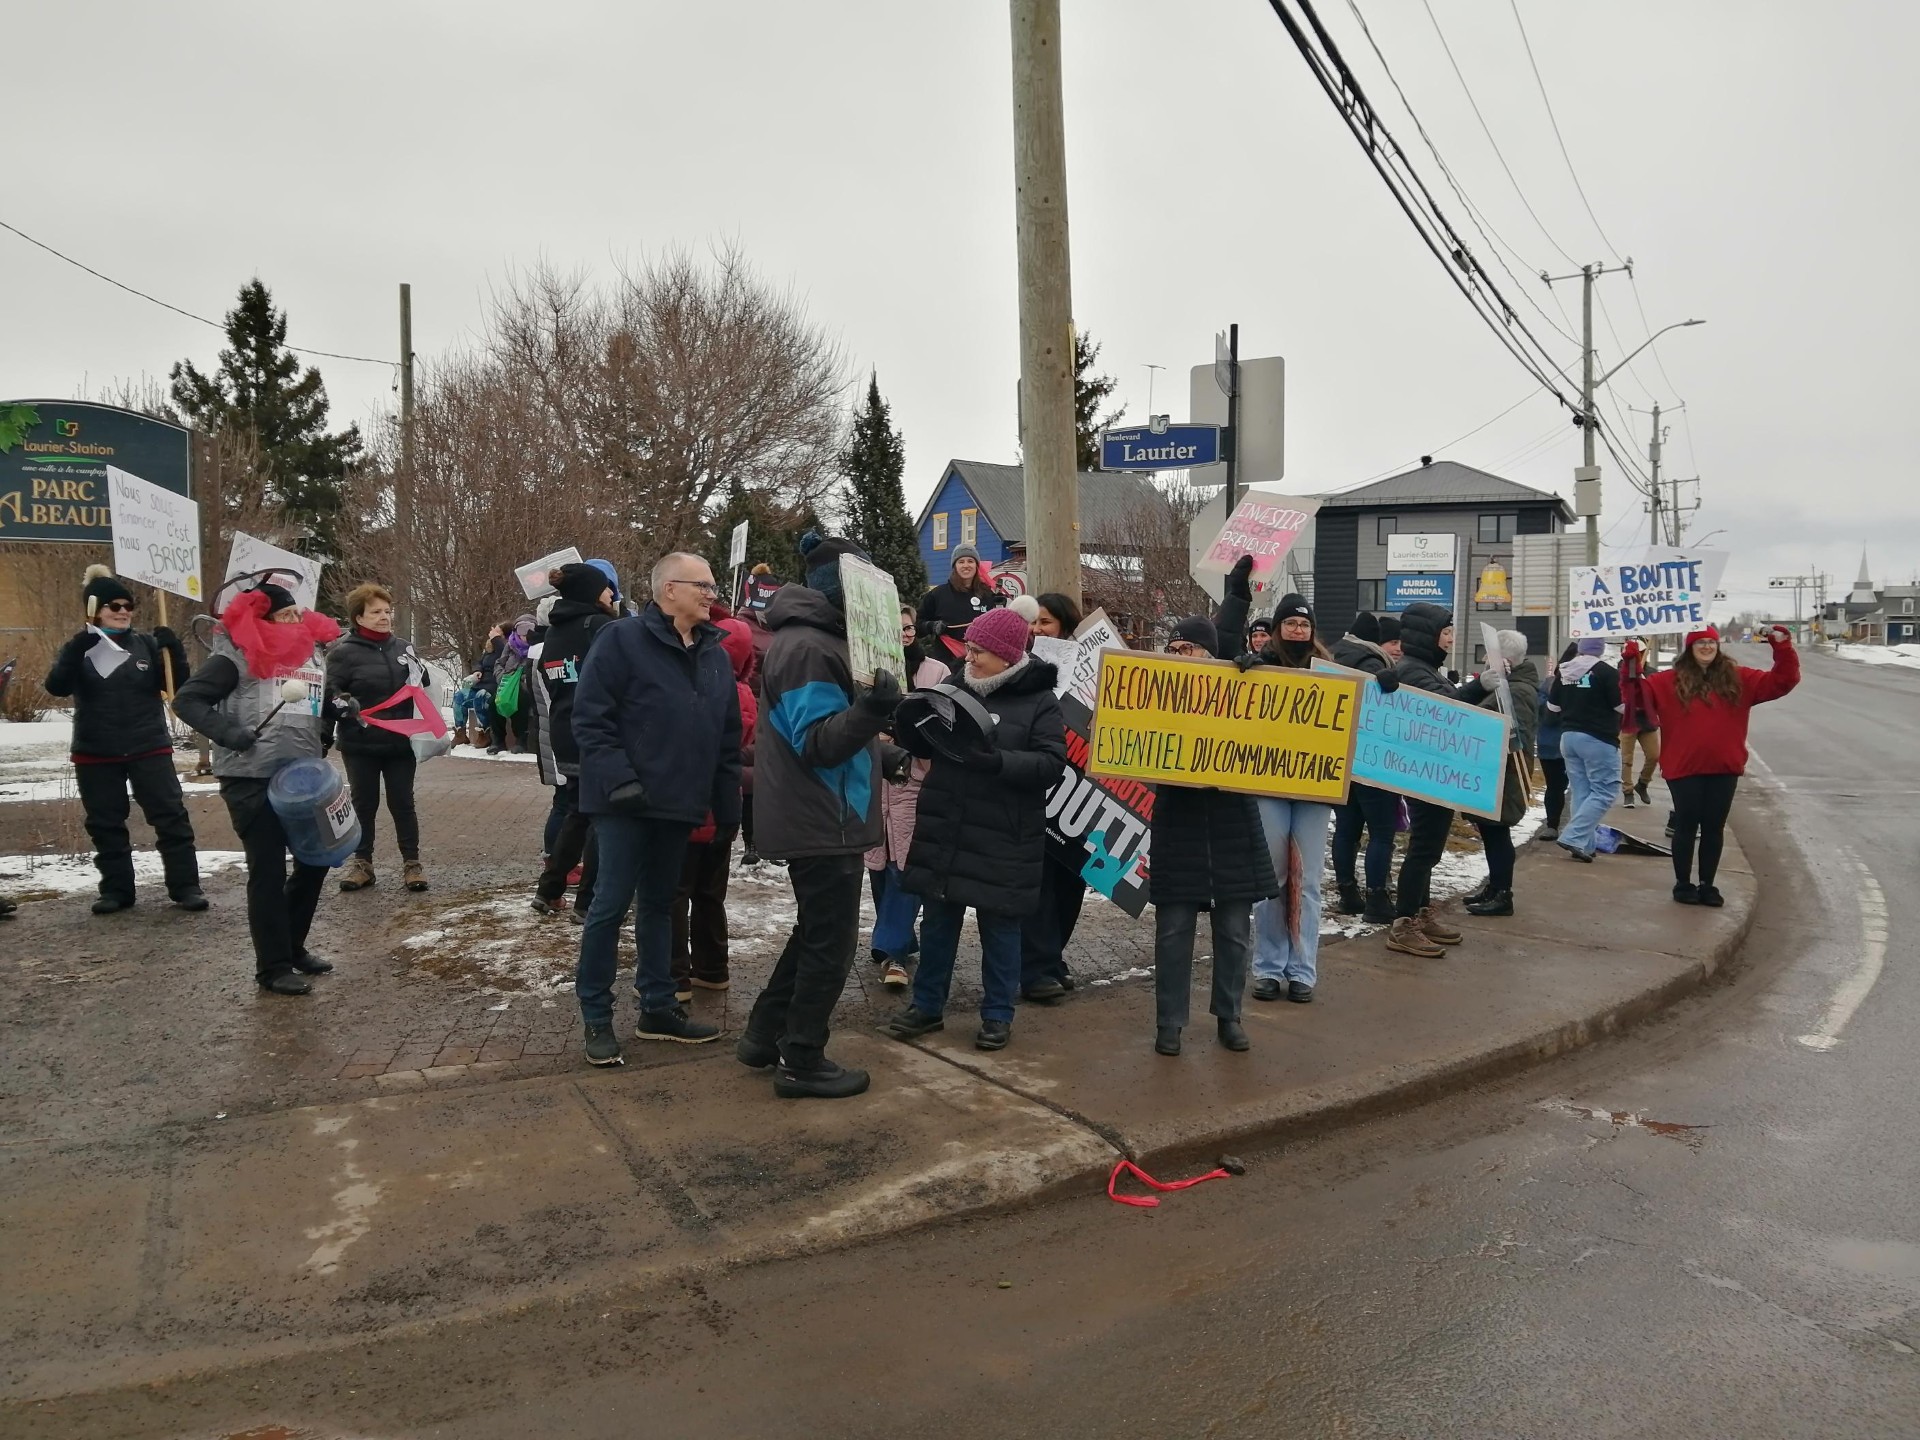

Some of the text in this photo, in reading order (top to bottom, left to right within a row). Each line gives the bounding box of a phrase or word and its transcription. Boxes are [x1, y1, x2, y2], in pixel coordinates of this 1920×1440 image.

[24, 440, 114, 455] Laurier-Station
[1106, 433, 1141, 442] Boulevard
[1123, 442, 1197, 462] Laurier
[31, 478, 95, 501] PARC
[115, 474, 140, 504] Nous
[1236, 502, 1308, 531] INVESTIR
[119, 535, 140, 551] nous
[1393, 551, 1449, 559] Laurier-Station
[1591, 560, 1702, 595] À BOUTTE
[1584, 591, 1674, 609] MAIS ENCORE
[1588, 603, 1703, 631] DEBOUTTE
[1076, 627, 1110, 662] AUTAIRE
[1103, 665, 1259, 721] RECONNAISSANCE
[1259, 684, 1289, 721] DU
[1289, 683, 1349, 731] RÔLE
[1364, 684, 1470, 728] INANCEMENT
[1097, 726, 1345, 782] ESSENTIEL DU COMMUNAUTAIRE
[1404, 719, 1487, 760] SUFFISANT
[1384, 749, 1482, 792] ORGANISMES
